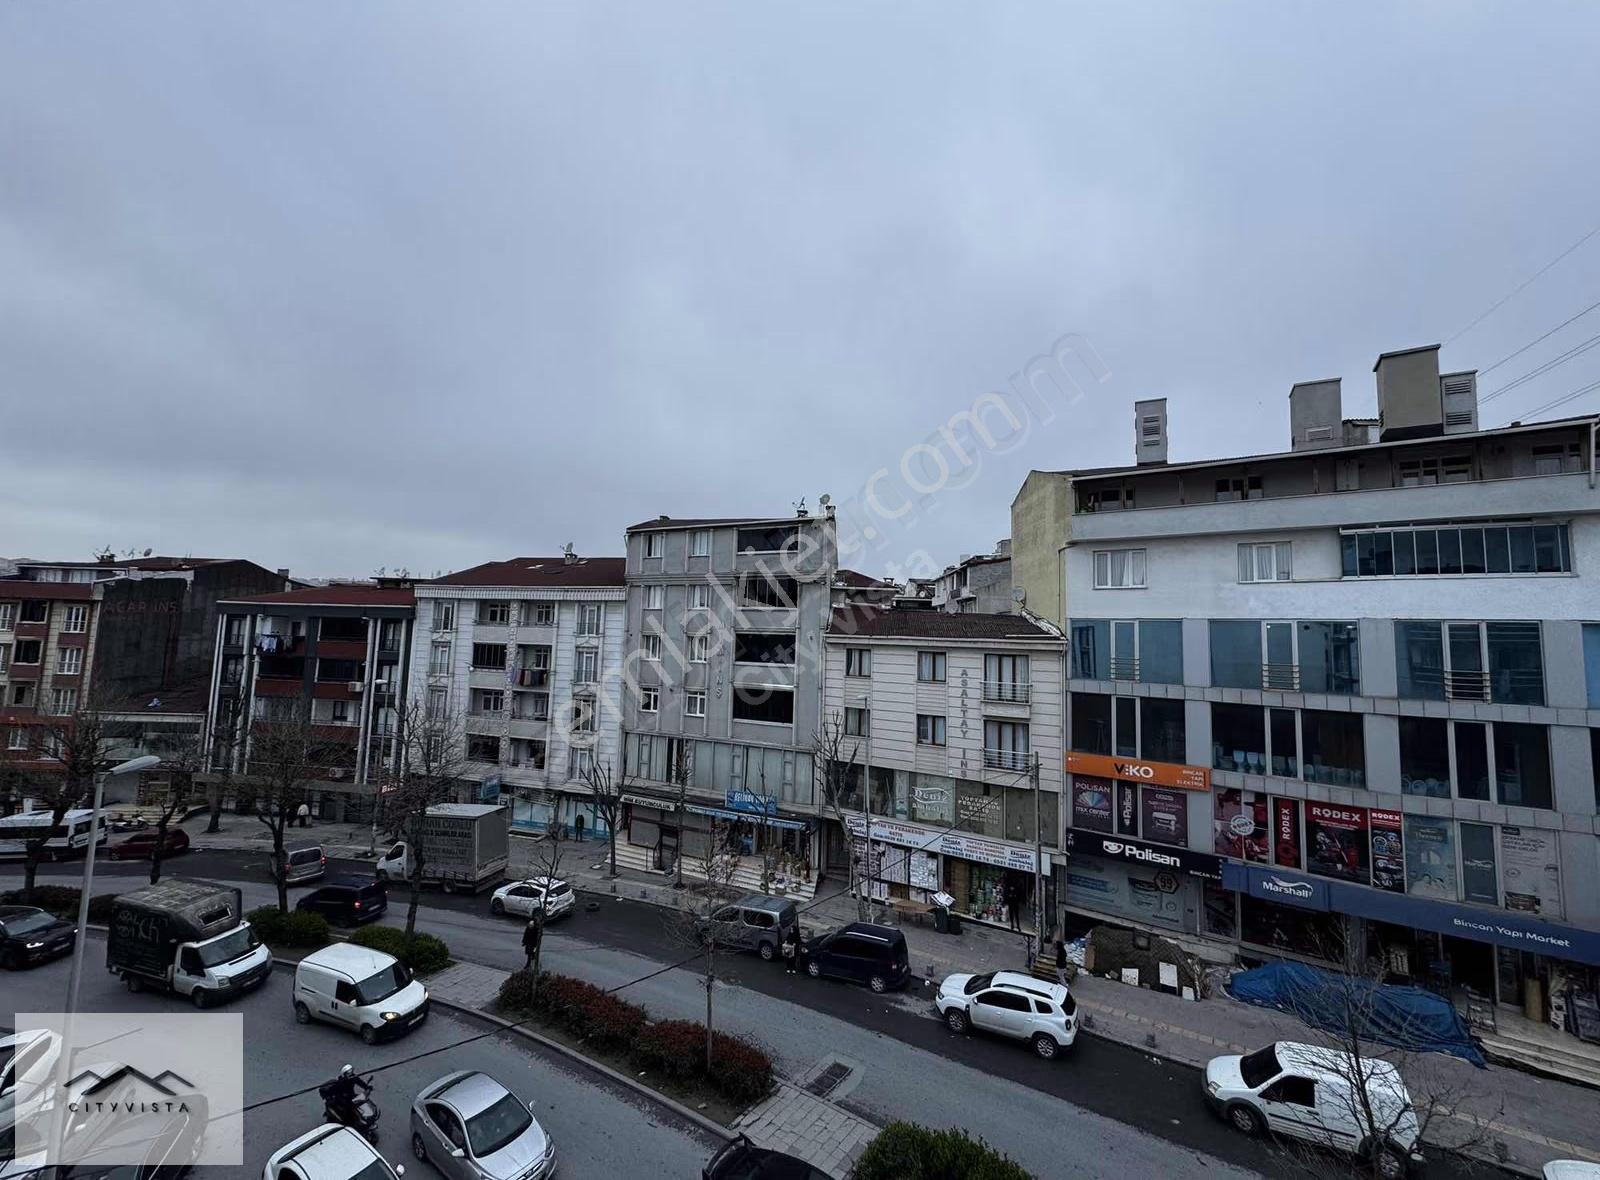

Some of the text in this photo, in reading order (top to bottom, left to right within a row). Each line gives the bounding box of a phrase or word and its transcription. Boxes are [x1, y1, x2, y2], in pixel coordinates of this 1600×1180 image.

[1312, 806, 1361, 822] RODEX
[1125, 845, 1180, 867] Polisan
[1262, 880, 1309, 898] Marshall
[1453, 918, 1571, 948] Bincan Yapı Market
